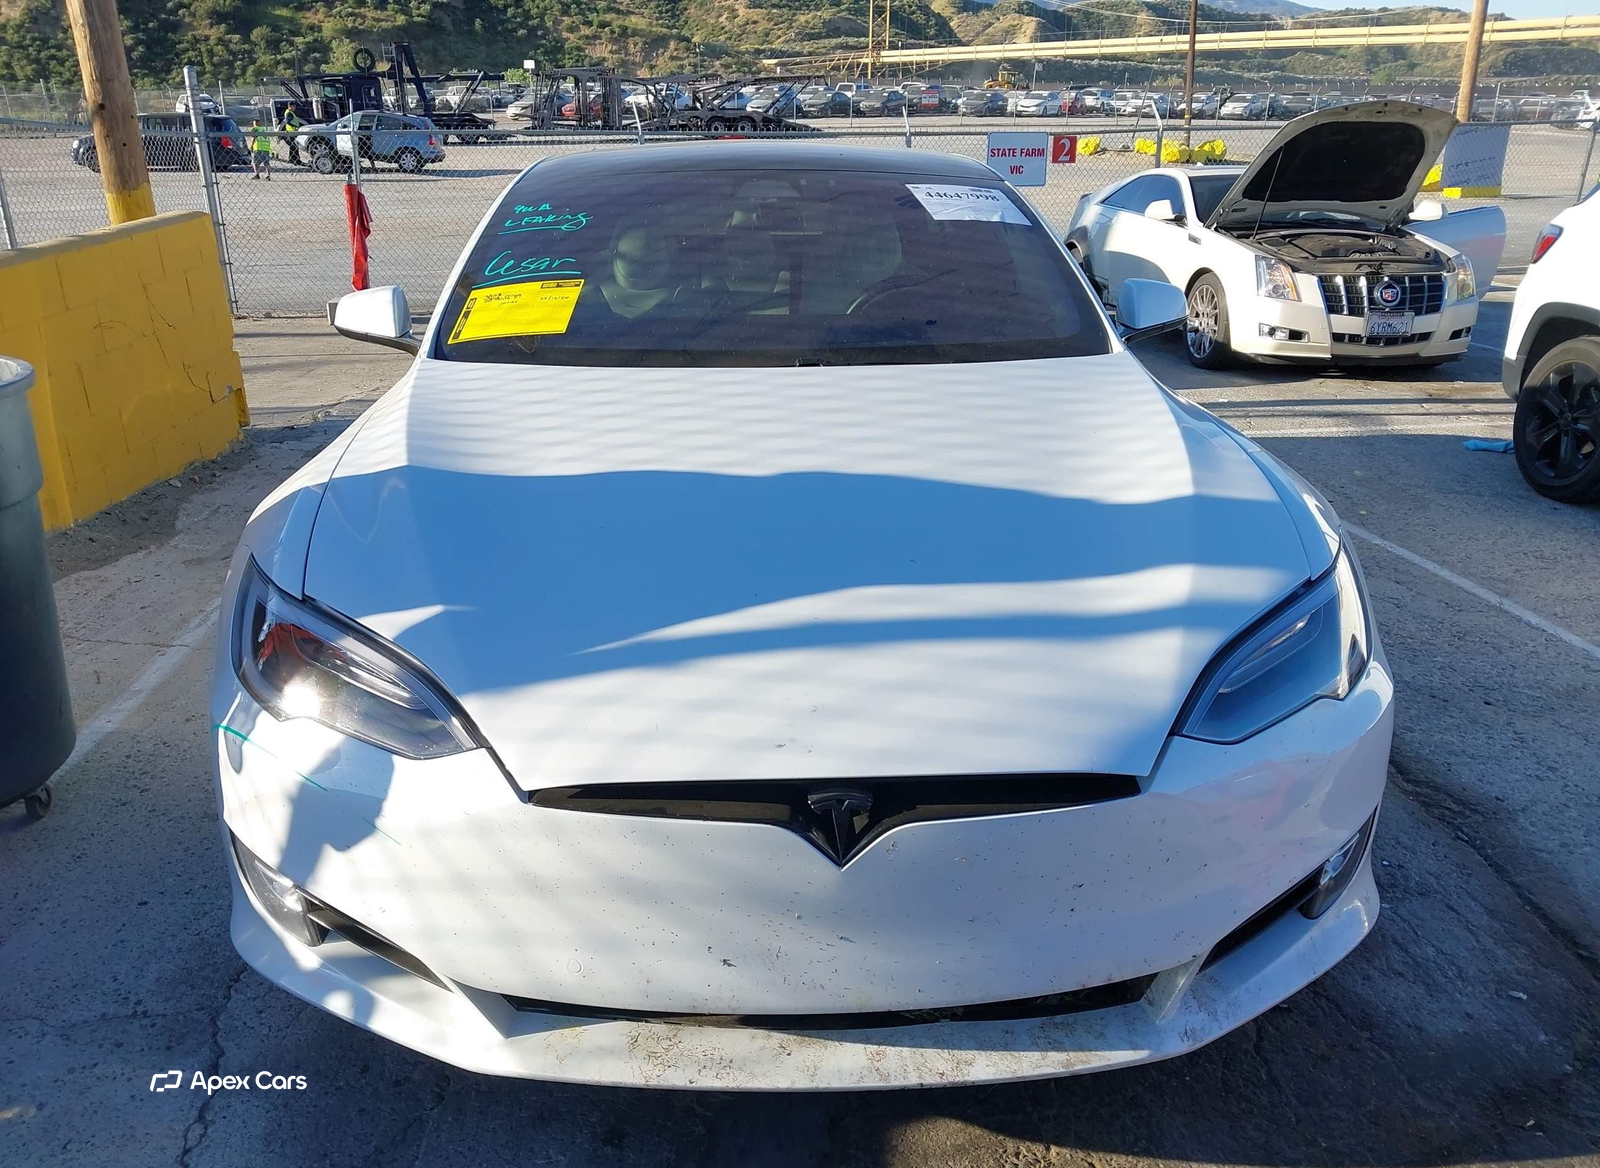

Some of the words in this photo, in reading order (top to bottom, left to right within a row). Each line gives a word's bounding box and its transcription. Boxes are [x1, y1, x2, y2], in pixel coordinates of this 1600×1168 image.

[990, 147, 1017, 158] STATE
[1020, 147, 1045, 158] FARM
[1058, 138, 1071, 161] 2
[1010, 165, 1024, 175] VIC
[1371, 321, 1408, 333] 6YRM621
